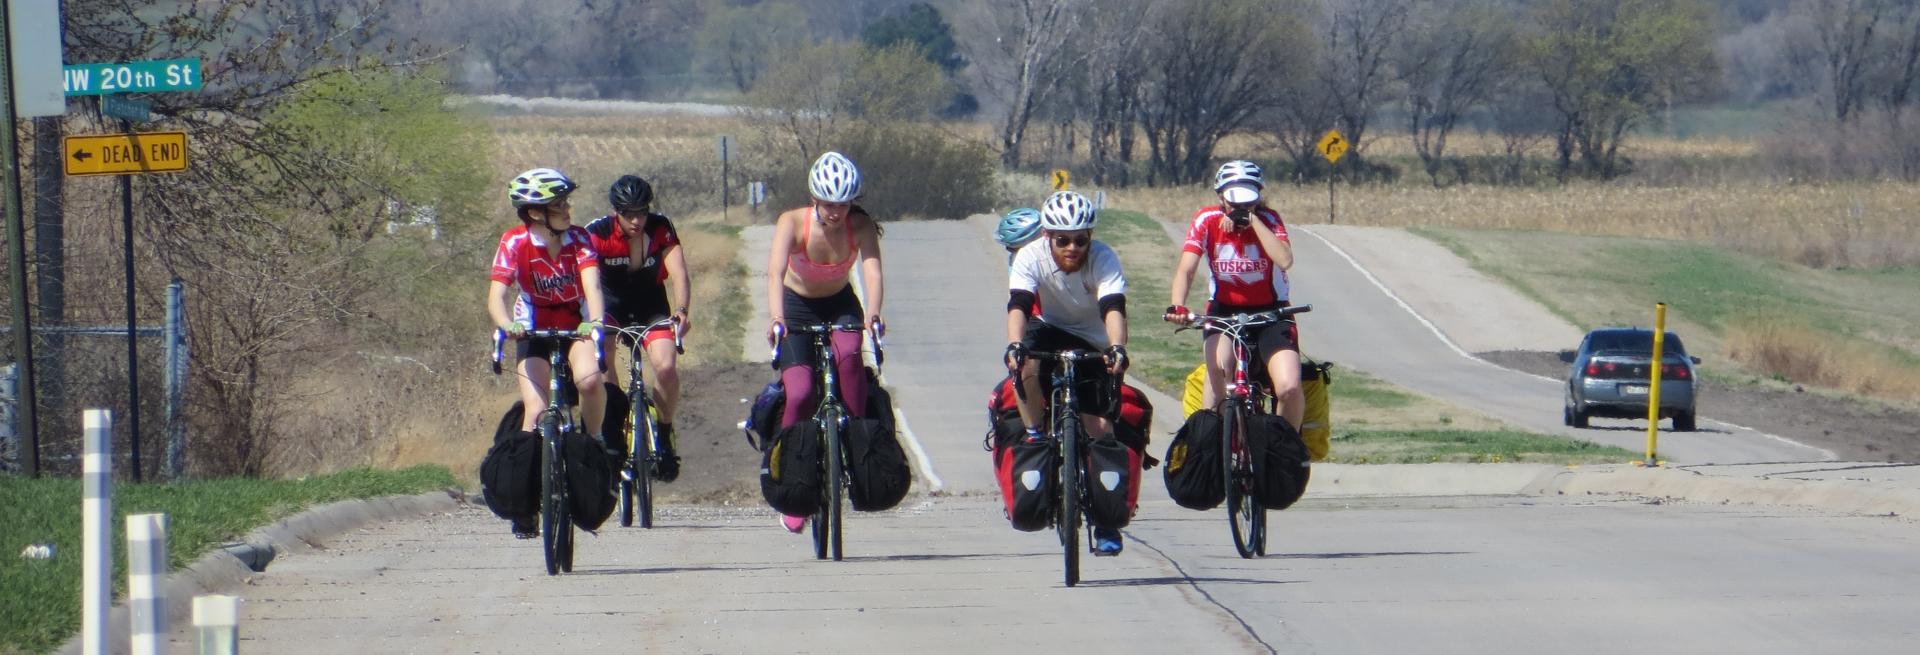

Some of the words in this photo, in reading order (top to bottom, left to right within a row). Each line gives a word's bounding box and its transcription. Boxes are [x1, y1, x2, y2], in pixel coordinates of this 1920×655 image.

[101, 67, 155, 90] 20th
[166, 64, 192, 86] St
[102, 144, 141, 164] DEAD
[151, 142, 180, 161] END
[1211, 259, 1268, 274] HUSKERS
